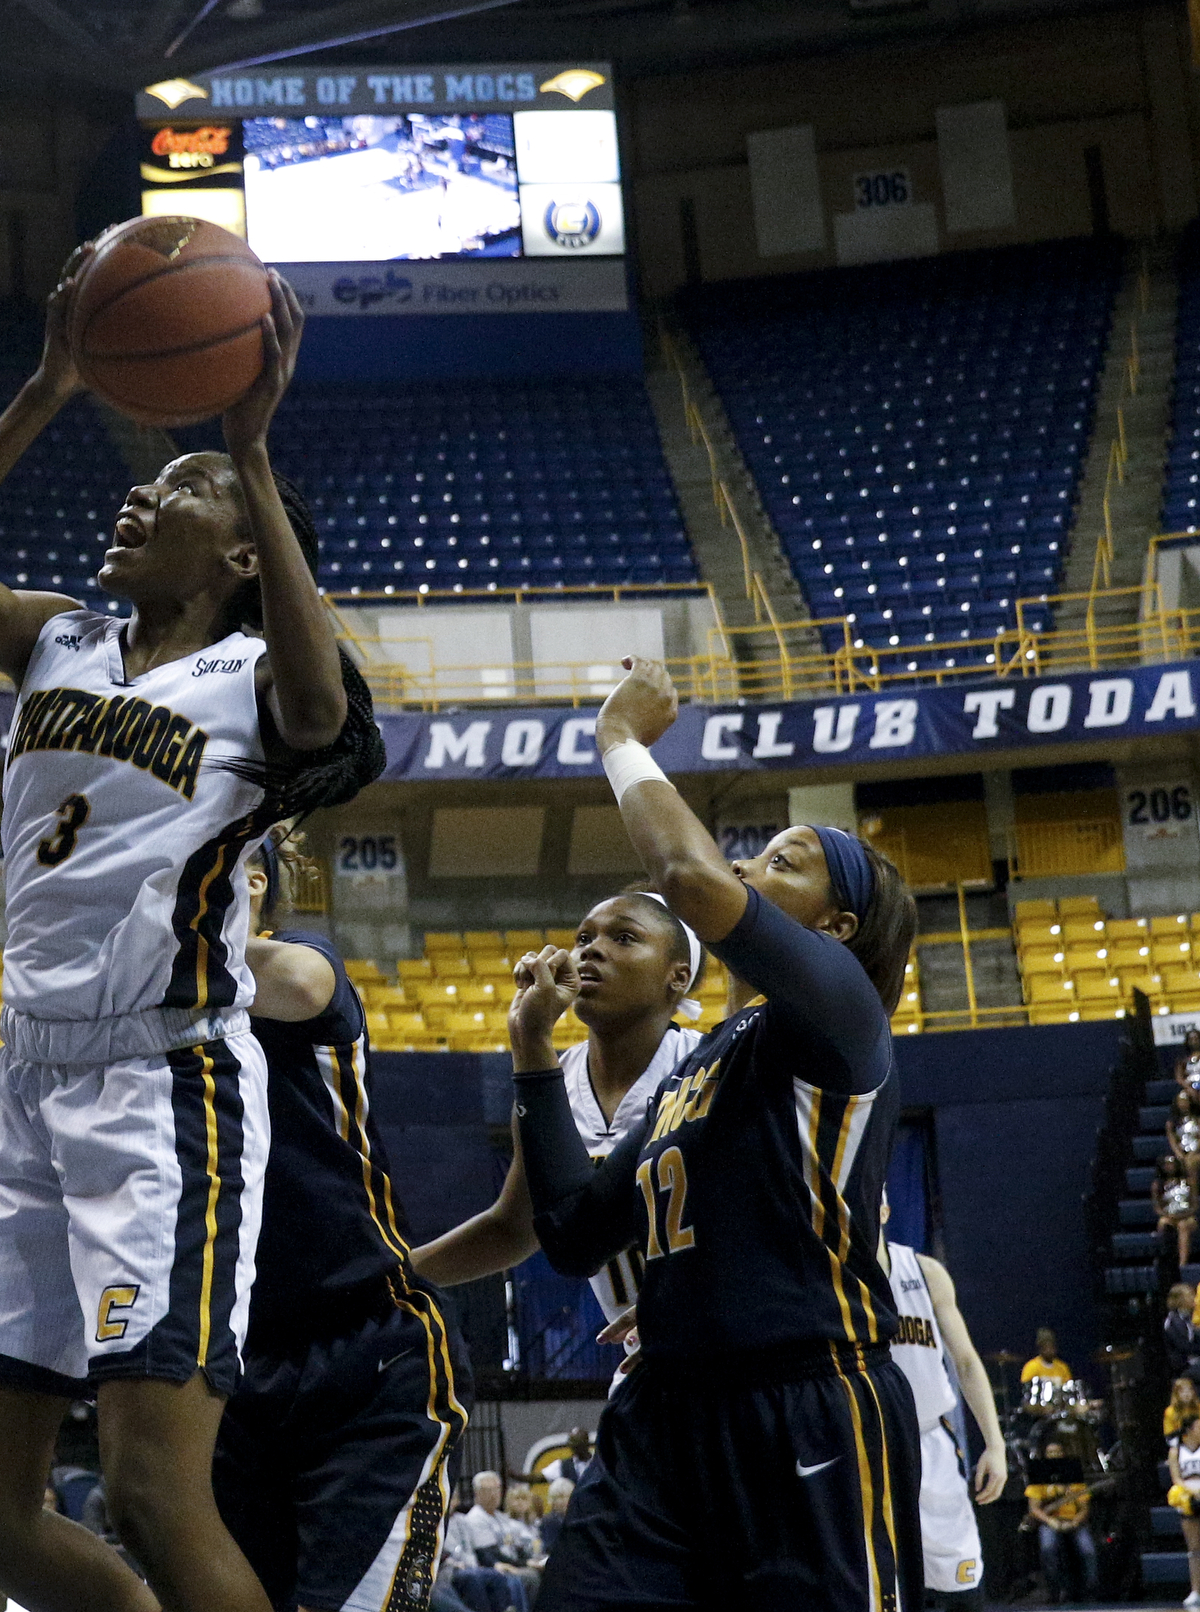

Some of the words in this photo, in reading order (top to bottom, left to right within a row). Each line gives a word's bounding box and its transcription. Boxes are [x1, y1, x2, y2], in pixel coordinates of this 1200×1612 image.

[212, 78, 305, 107] HOME
[317, 76, 357, 103] OF
[366, 74, 436, 102] THE
[446, 72, 537, 101] MOCS
[855, 173, 909, 207] 306
[332, 269, 413, 309] epb
[423, 281, 492, 303] Fiber
[496, 280, 561, 308] Optics
[701, 698, 918, 761] CLUB
[963, 669, 1197, 740] TODA
[1128, 785, 1192, 826] 206
[36, 793, 92, 868] 3
[340, 835, 397, 871] 205
[644, 1057, 721, 1150] NCG
[636, 1144, 696, 1262] 12
[892, 1314, 937, 1349] OOGA
